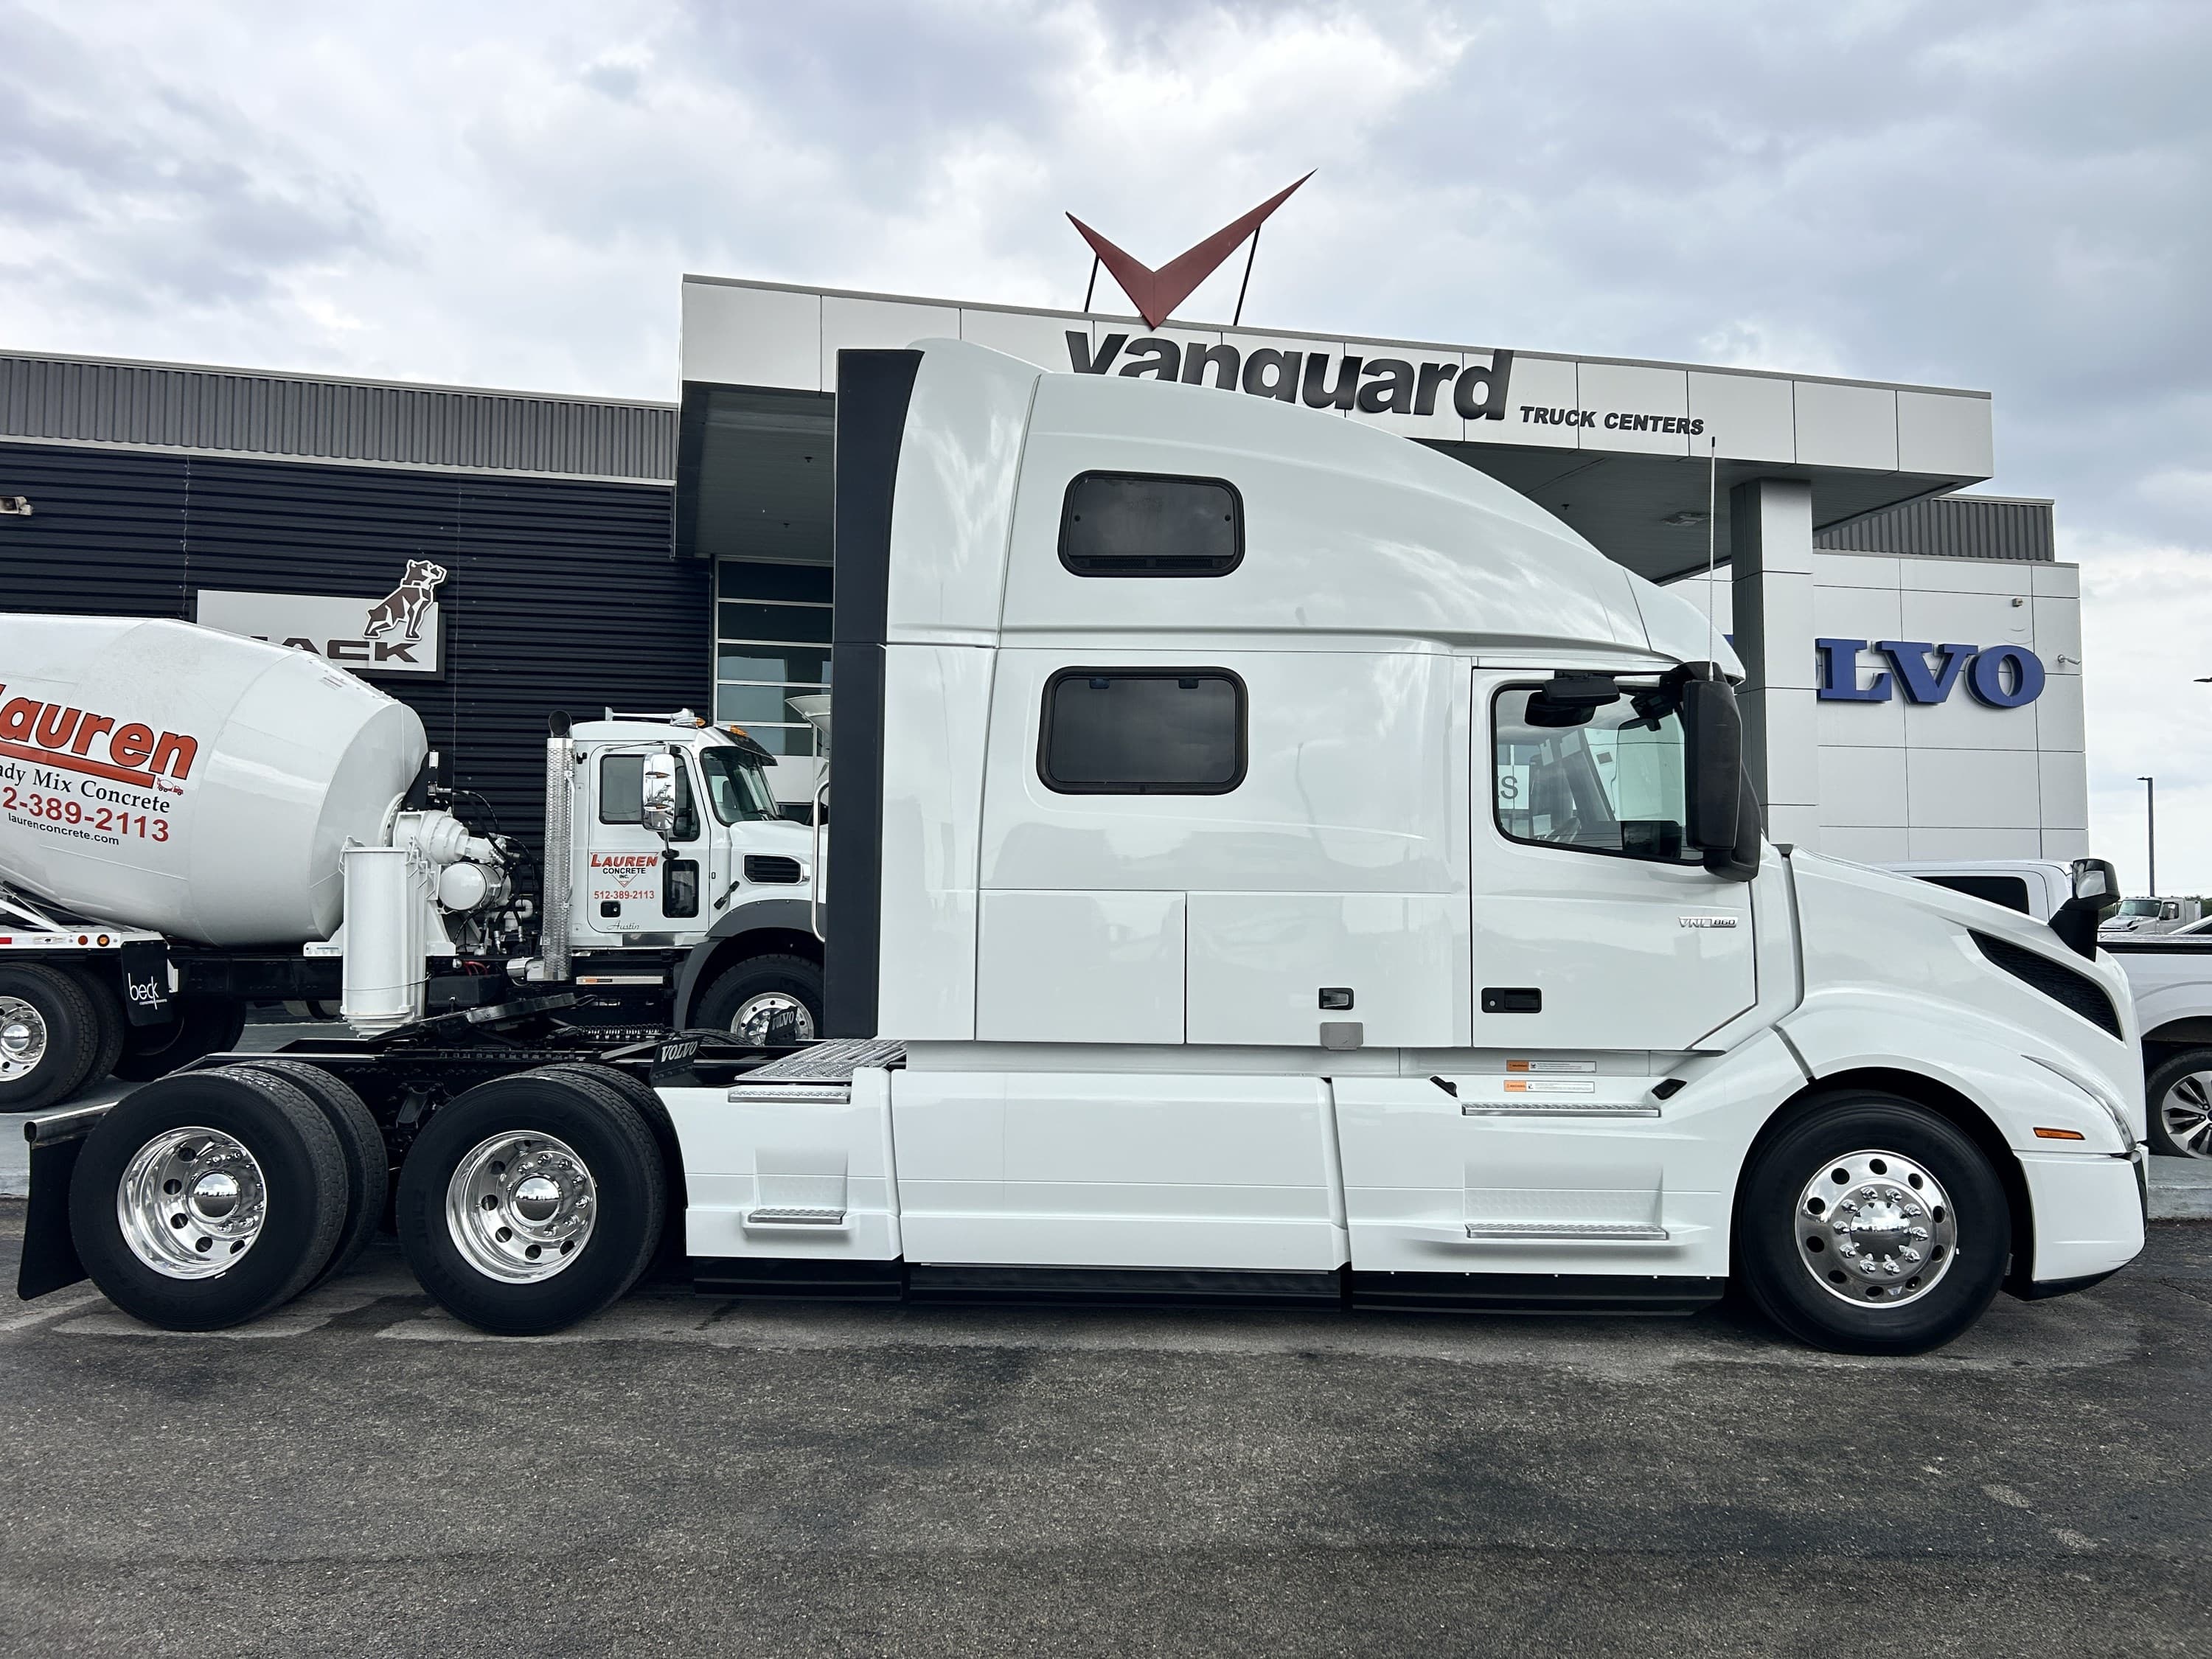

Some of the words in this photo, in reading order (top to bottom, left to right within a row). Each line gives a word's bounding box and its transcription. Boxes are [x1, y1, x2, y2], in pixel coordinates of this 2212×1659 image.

[1520, 406, 1597, 428] TRUCK
[1604, 412, 1705, 435] CENTERS
[250, 636, 420, 664] ACK
[1815, 638, 2046, 709] LVO
[0, 684, 198, 781] auren
[32, 768, 72, 793] Mix
[80, 780, 170, 813] Concrete
[1498, 775, 1519, 800] S
[8, 812, 120, 846] laurenconcrete.com
[591, 854, 658, 867] LAUREN
[594, 890, 655, 900] 512-389-2113
[606, 919, 640, 931] Austin
[128, 973, 159, 1010] beck
[661, 1040, 699, 1062] VOLVO
